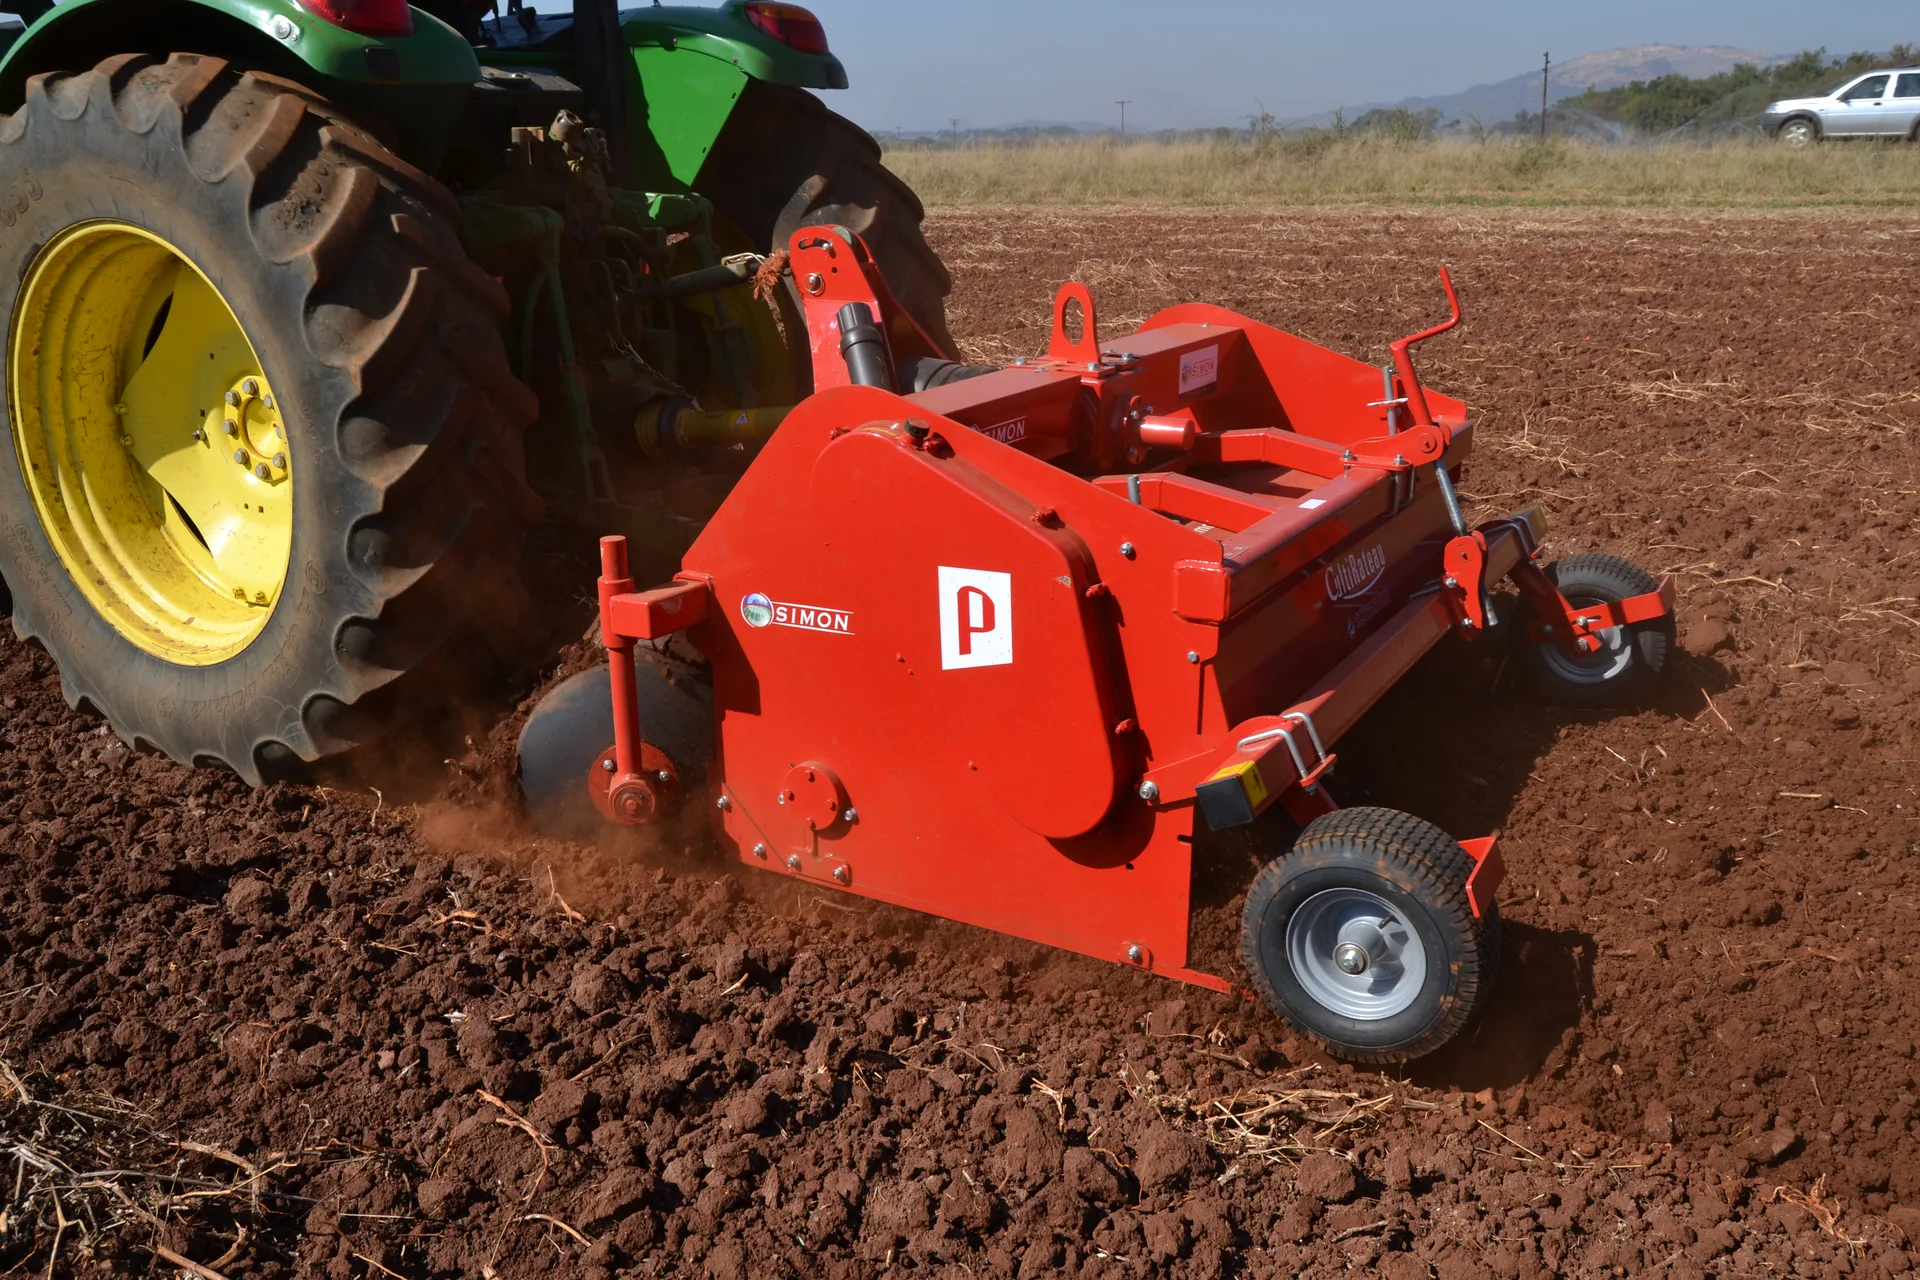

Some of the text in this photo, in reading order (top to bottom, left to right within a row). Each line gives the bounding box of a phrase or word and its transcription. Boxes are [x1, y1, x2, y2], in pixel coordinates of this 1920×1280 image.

[1191, 361, 1215, 377] SIMON
[1325, 544, 1386, 600] CultiRateau
[776, 606, 849, 631] SIMON
[957, 586, 996, 656] P
